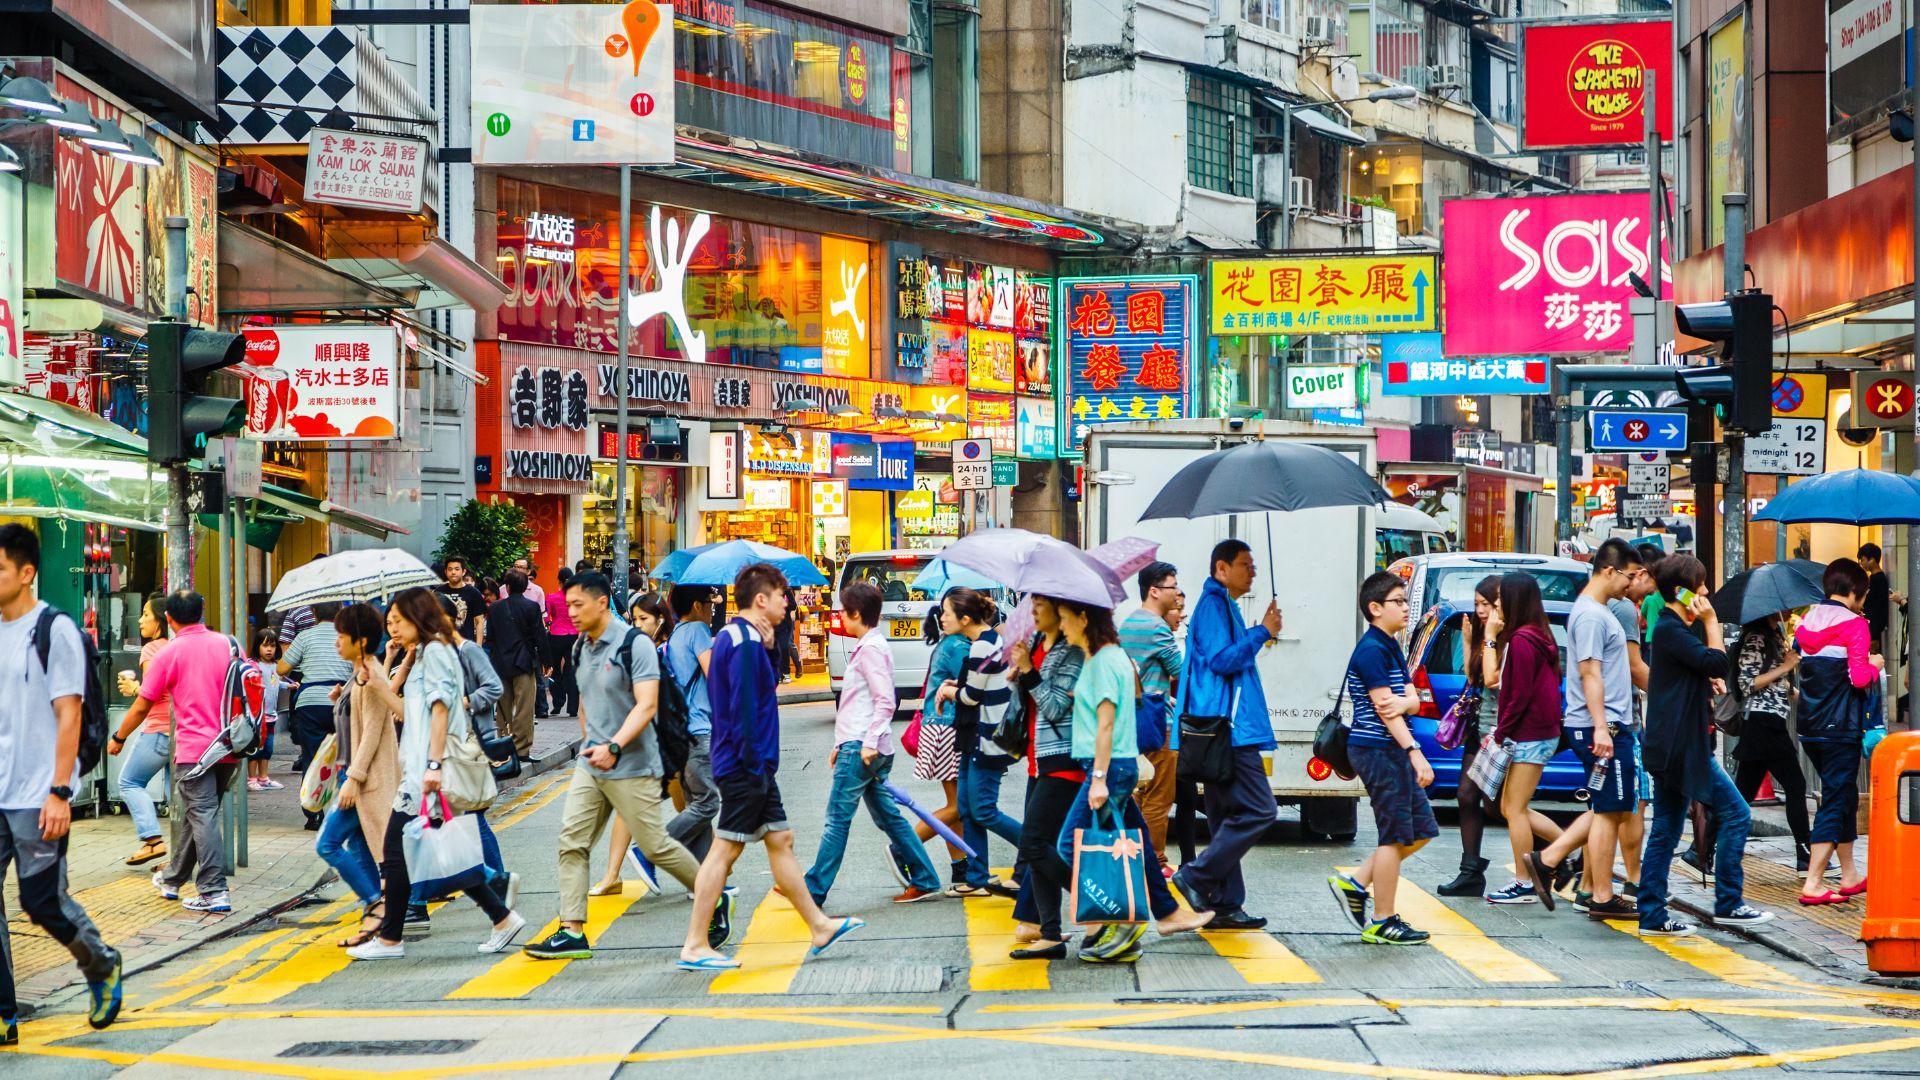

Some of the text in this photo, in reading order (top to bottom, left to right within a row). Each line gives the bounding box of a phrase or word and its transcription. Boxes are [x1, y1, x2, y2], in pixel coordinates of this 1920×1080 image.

[702, 0, 735, 28] HOUSE
[1841, 1, 1892, 48] Shop 104-106 & 109
[1588, 44, 1623, 65] THE
[1586, 92, 1632, 115] HOUSE
[1590, 123, 1624, 131] Since 1979
[317, 154, 415, 178] KAM LOK SAUNA
[59, 151, 83, 215] MX
[527, 211, 575, 246] 大快活
[527, 244, 575, 262] Fairwood
[946, 273, 963, 290] ANA
[1221, 264, 1409, 307] 花園餐廳
[1071, 290, 1165, 337] 花園
[1223, 312, 1293, 328] 金百利商場
[1297, 311, 1320, 327] 4/F
[1544, 293, 1622, 341] 莎莎
[823, 327, 850, 346] 大快活
[898, 332, 929, 349] KYOTO
[315, 343, 370, 362] 順興隆
[898, 351, 928, 369] PLAZA
[1082, 342, 1180, 391] 餐廳
[1410, 359, 1543, 382] 銀河中西大藥
[296, 367, 389, 387] 汽水士多店
[1292, 372, 1344, 395] Cover
[307, 397, 377, 406] 波斯富街30號後巷
[511, 365, 588, 431] 吉野家
[715, 377, 750, 408] 吉野家
[1072, 395, 1179, 420] 牛扒之家
[1762, 432, 1780, 441] 中午
[1795, 425, 1817, 441] 12
[508, 450, 593, 481] YOSHINOYA
[768, 461, 813, 473] DISPENSARY
[1752, 449, 1816, 468] midnight 12
[1761, 459, 1779, 467] 午夜
[957, 465, 987, 473] 24 hrs
[1654, 467, 1666, 477] 12
[961, 475, 984, 486] 全日
[1654, 483, 1666, 493] 12
[894, 628, 917, 636] 870
[898, 620, 912, 629] GV
[1302, 709, 1325, 717] 2760
[1083, 877, 1122, 916] SATAMI
